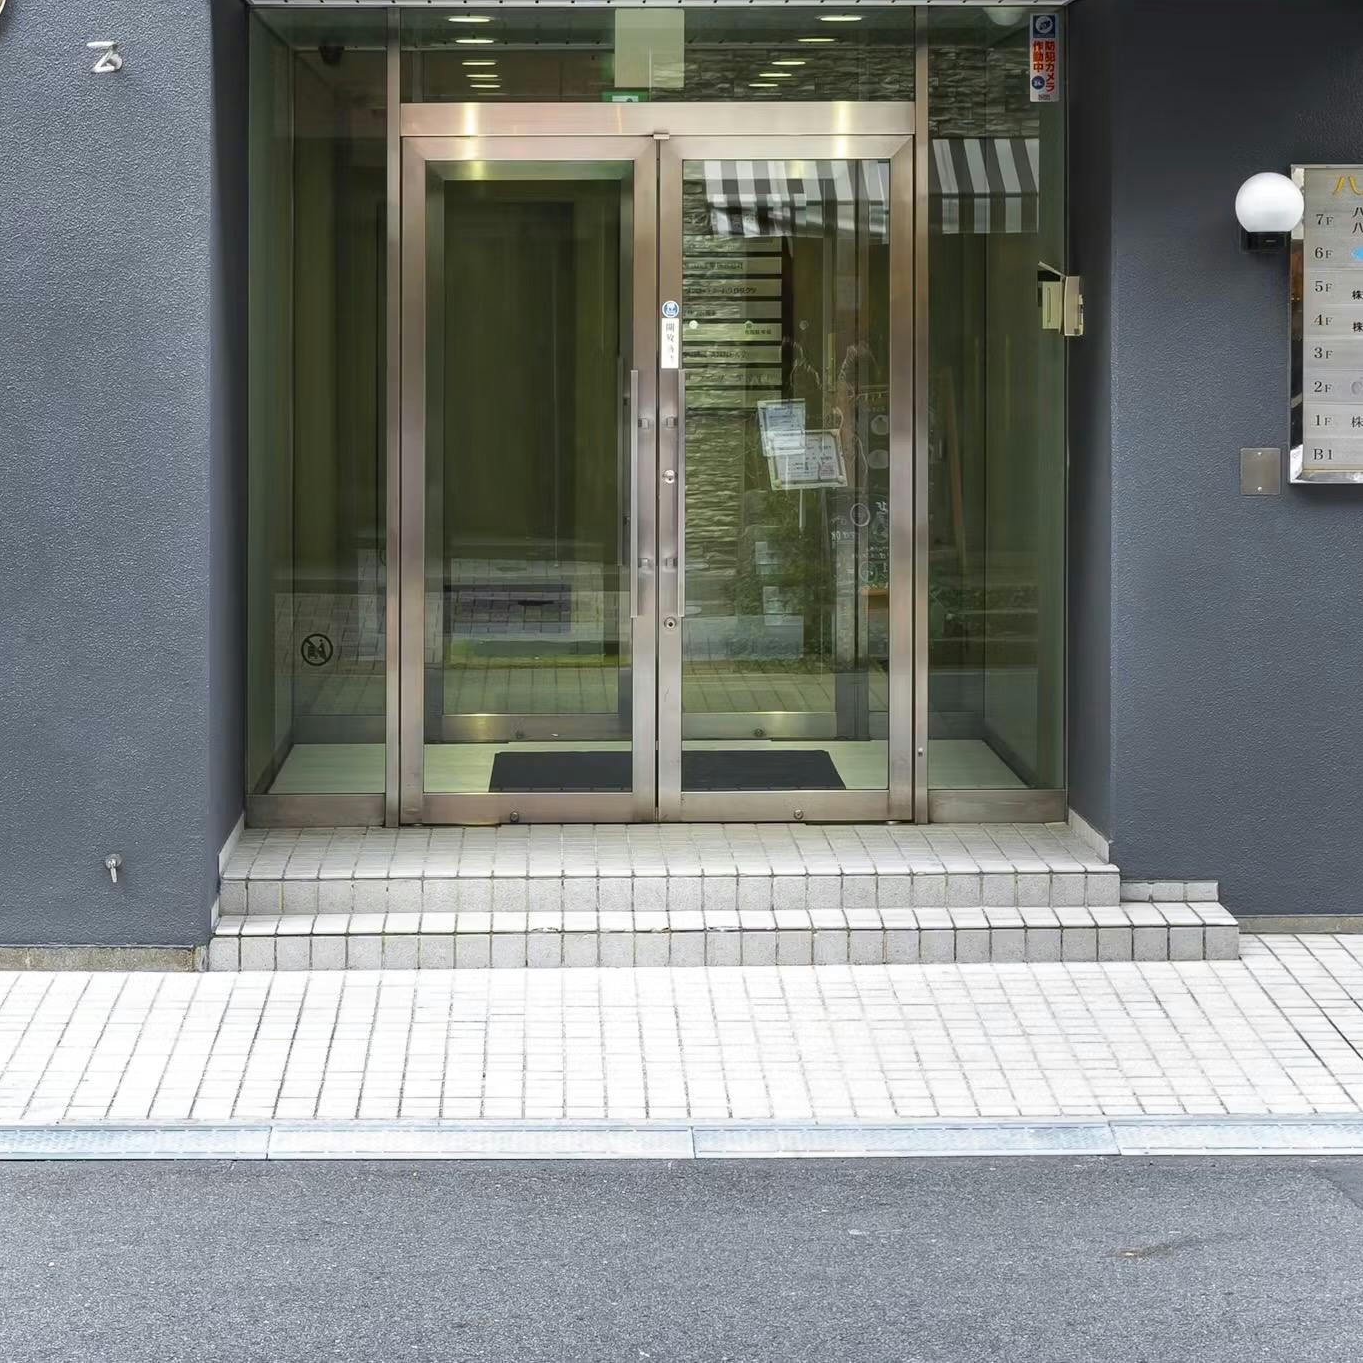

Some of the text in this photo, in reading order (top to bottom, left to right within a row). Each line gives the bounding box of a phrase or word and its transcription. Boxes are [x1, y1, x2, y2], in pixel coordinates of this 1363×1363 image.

[1032, 40, 1044, 73] 作動中
[1044, 40, 1056, 93] 防犯カメラ
[1315, 213, 1335, 226] 7F
[1314, 246, 1334, 260] 6F
[1313, 279, 1333, 293] 5F
[1313, 313, 1334, 327] 4F
[1313, 346, 1334, 360] 3F
[1313, 380, 1333, 394] 2F
[1312, 448, 1334, 461] B1
